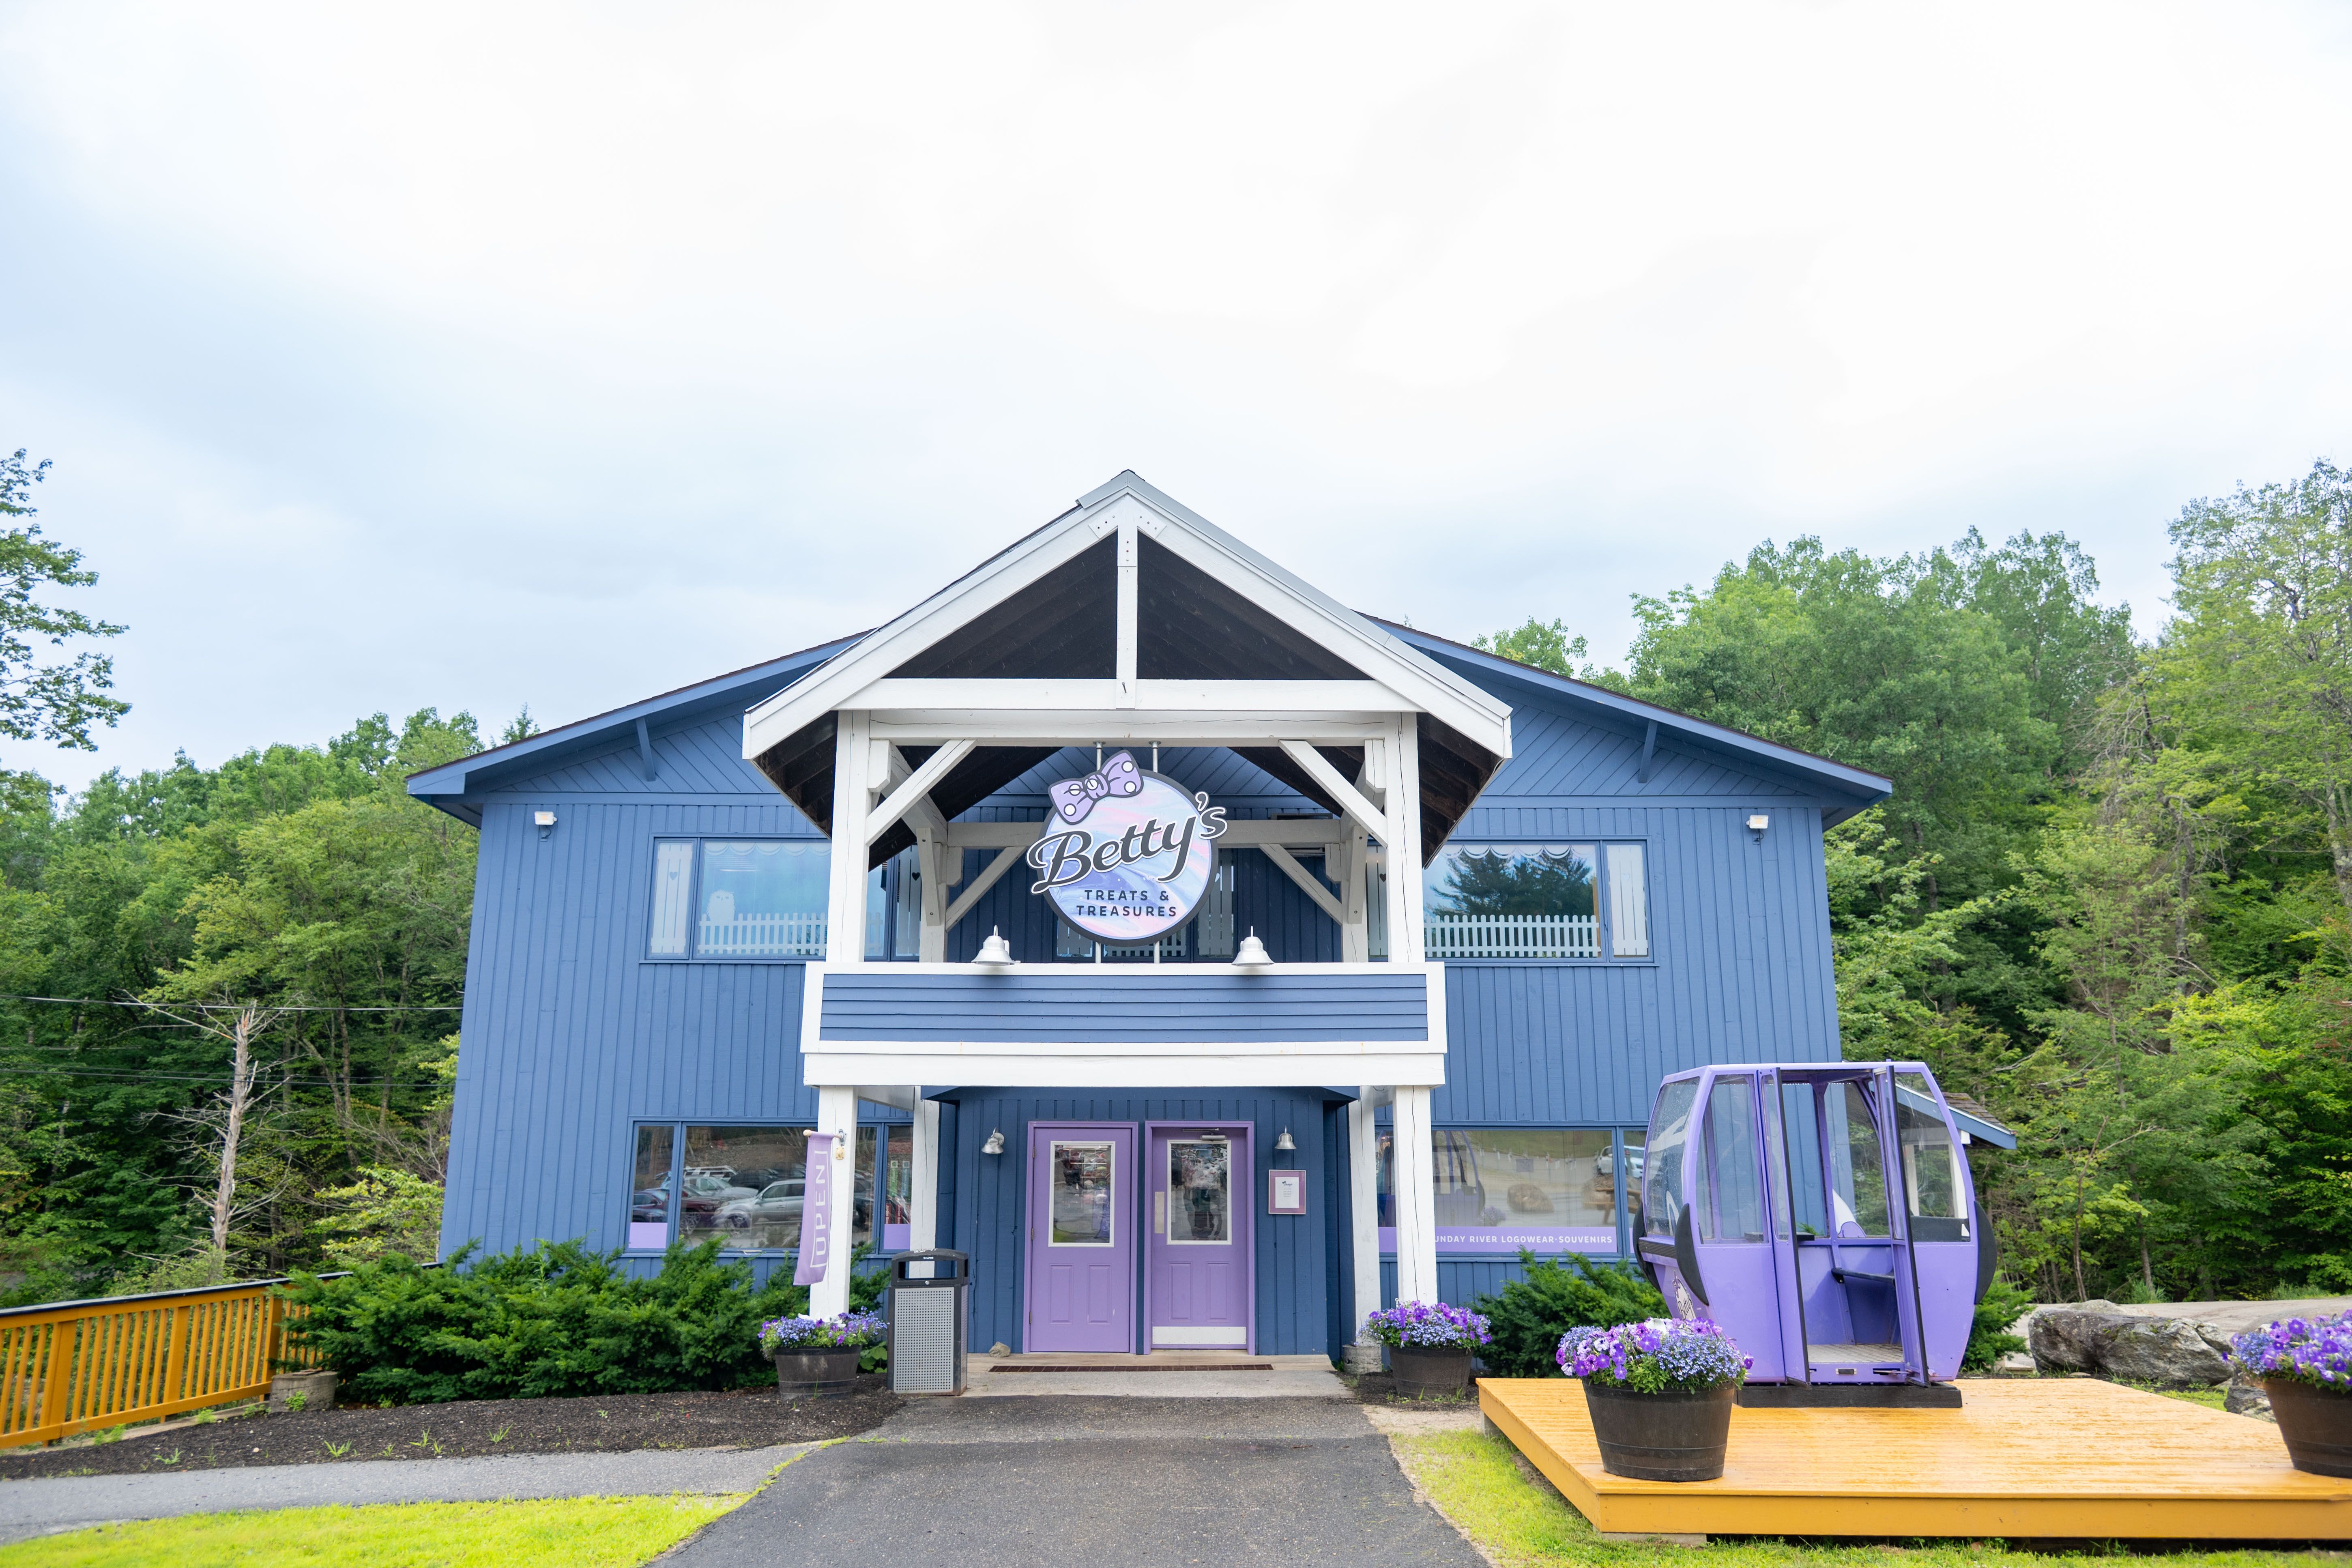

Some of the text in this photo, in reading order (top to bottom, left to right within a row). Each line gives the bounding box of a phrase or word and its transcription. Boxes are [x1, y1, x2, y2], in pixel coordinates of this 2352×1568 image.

[1027, 791, 1229, 895] Betty's
[1076, 905, 1177, 917] TREASURES
[1084, 889, 1169, 901] TREATS &
[815, 1164, 827, 1256] OPEN
